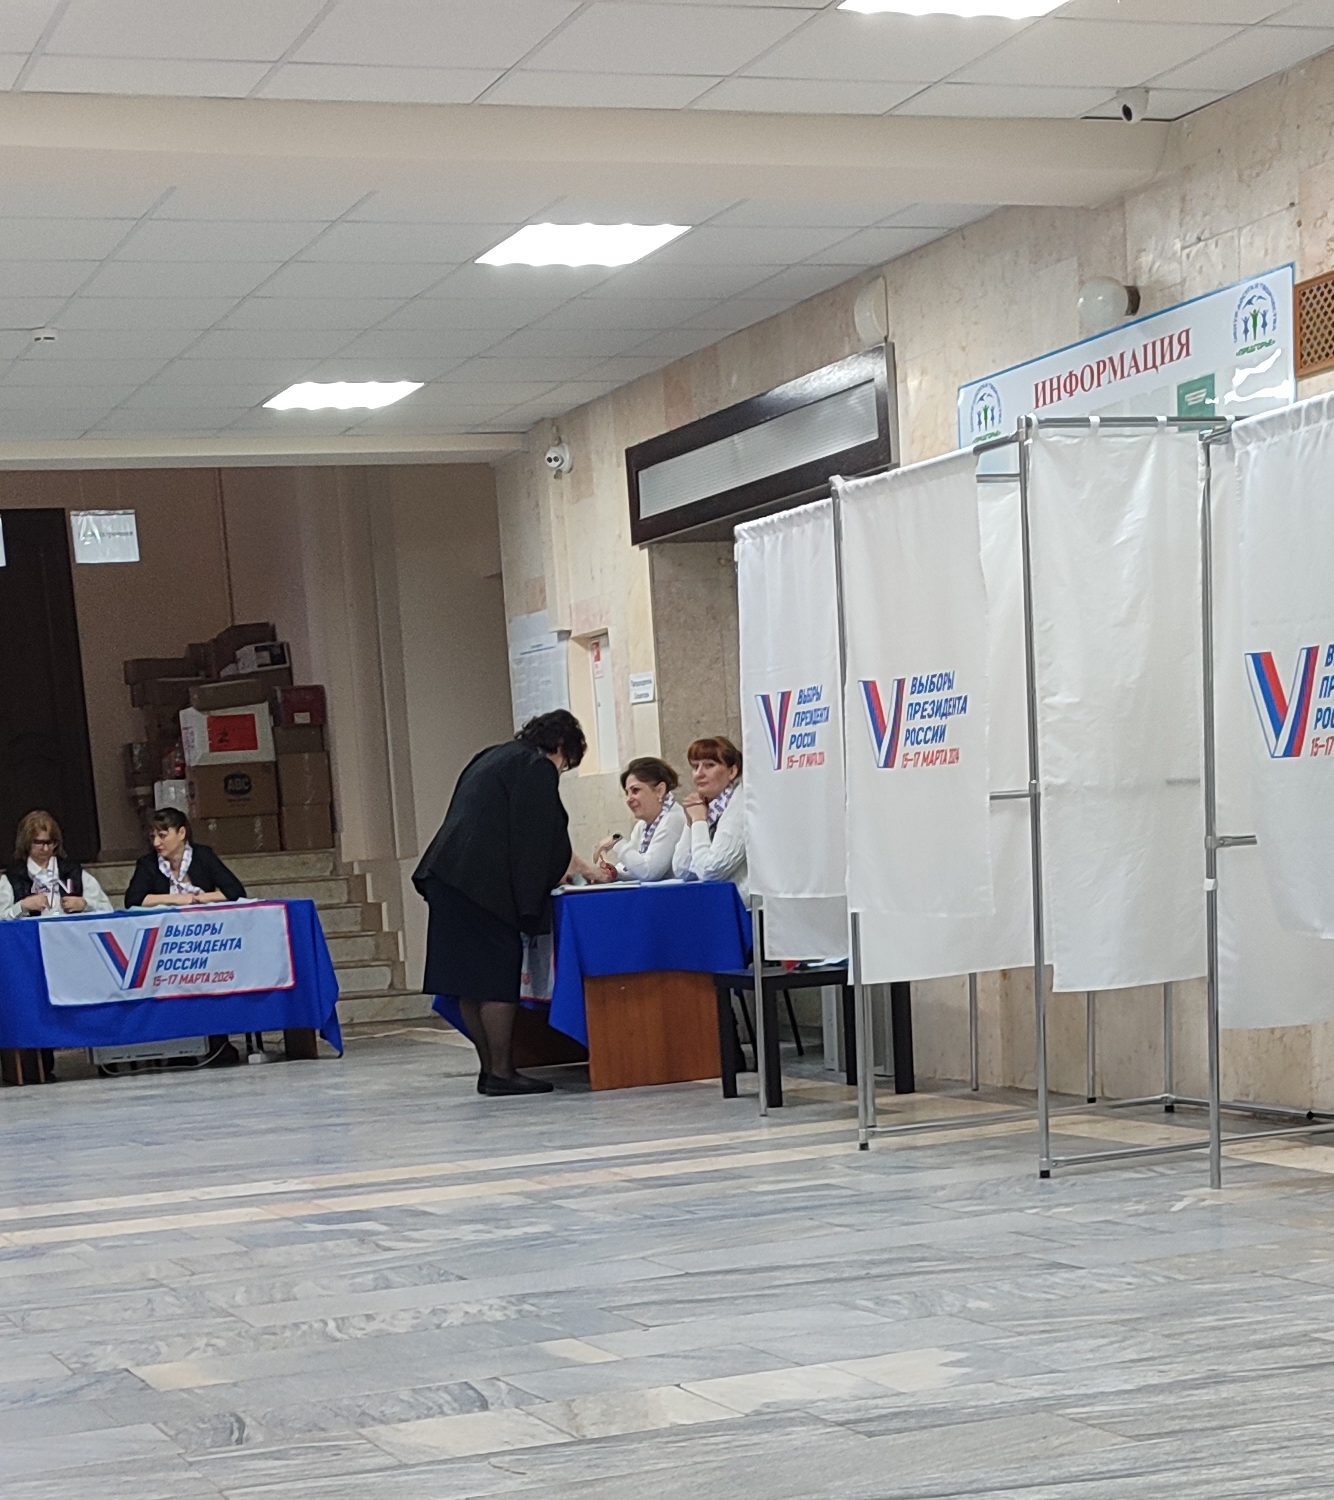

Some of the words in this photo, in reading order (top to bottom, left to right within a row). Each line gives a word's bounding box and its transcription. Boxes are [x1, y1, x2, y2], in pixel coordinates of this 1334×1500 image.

[1033, 327, 1192, 411] ИНФОРМАЦИЯ
[910, 671, 955, 696] ВЫБОРЫ
[906, 695, 968, 722] ПРЕЗИДЕНТА
[903, 724, 947, 747] РОССИИ
[921, 749, 947, 766] МАРТА
[164, 922, 224, 938] ВЫБОРЫ
[159, 937, 242, 955] ПРЕЗИДЕНТА
[155, 957, 209, 972] РОССИИ
[178, 972, 210, 985] МАРТА
[212, 970, 235, 983] 2024
